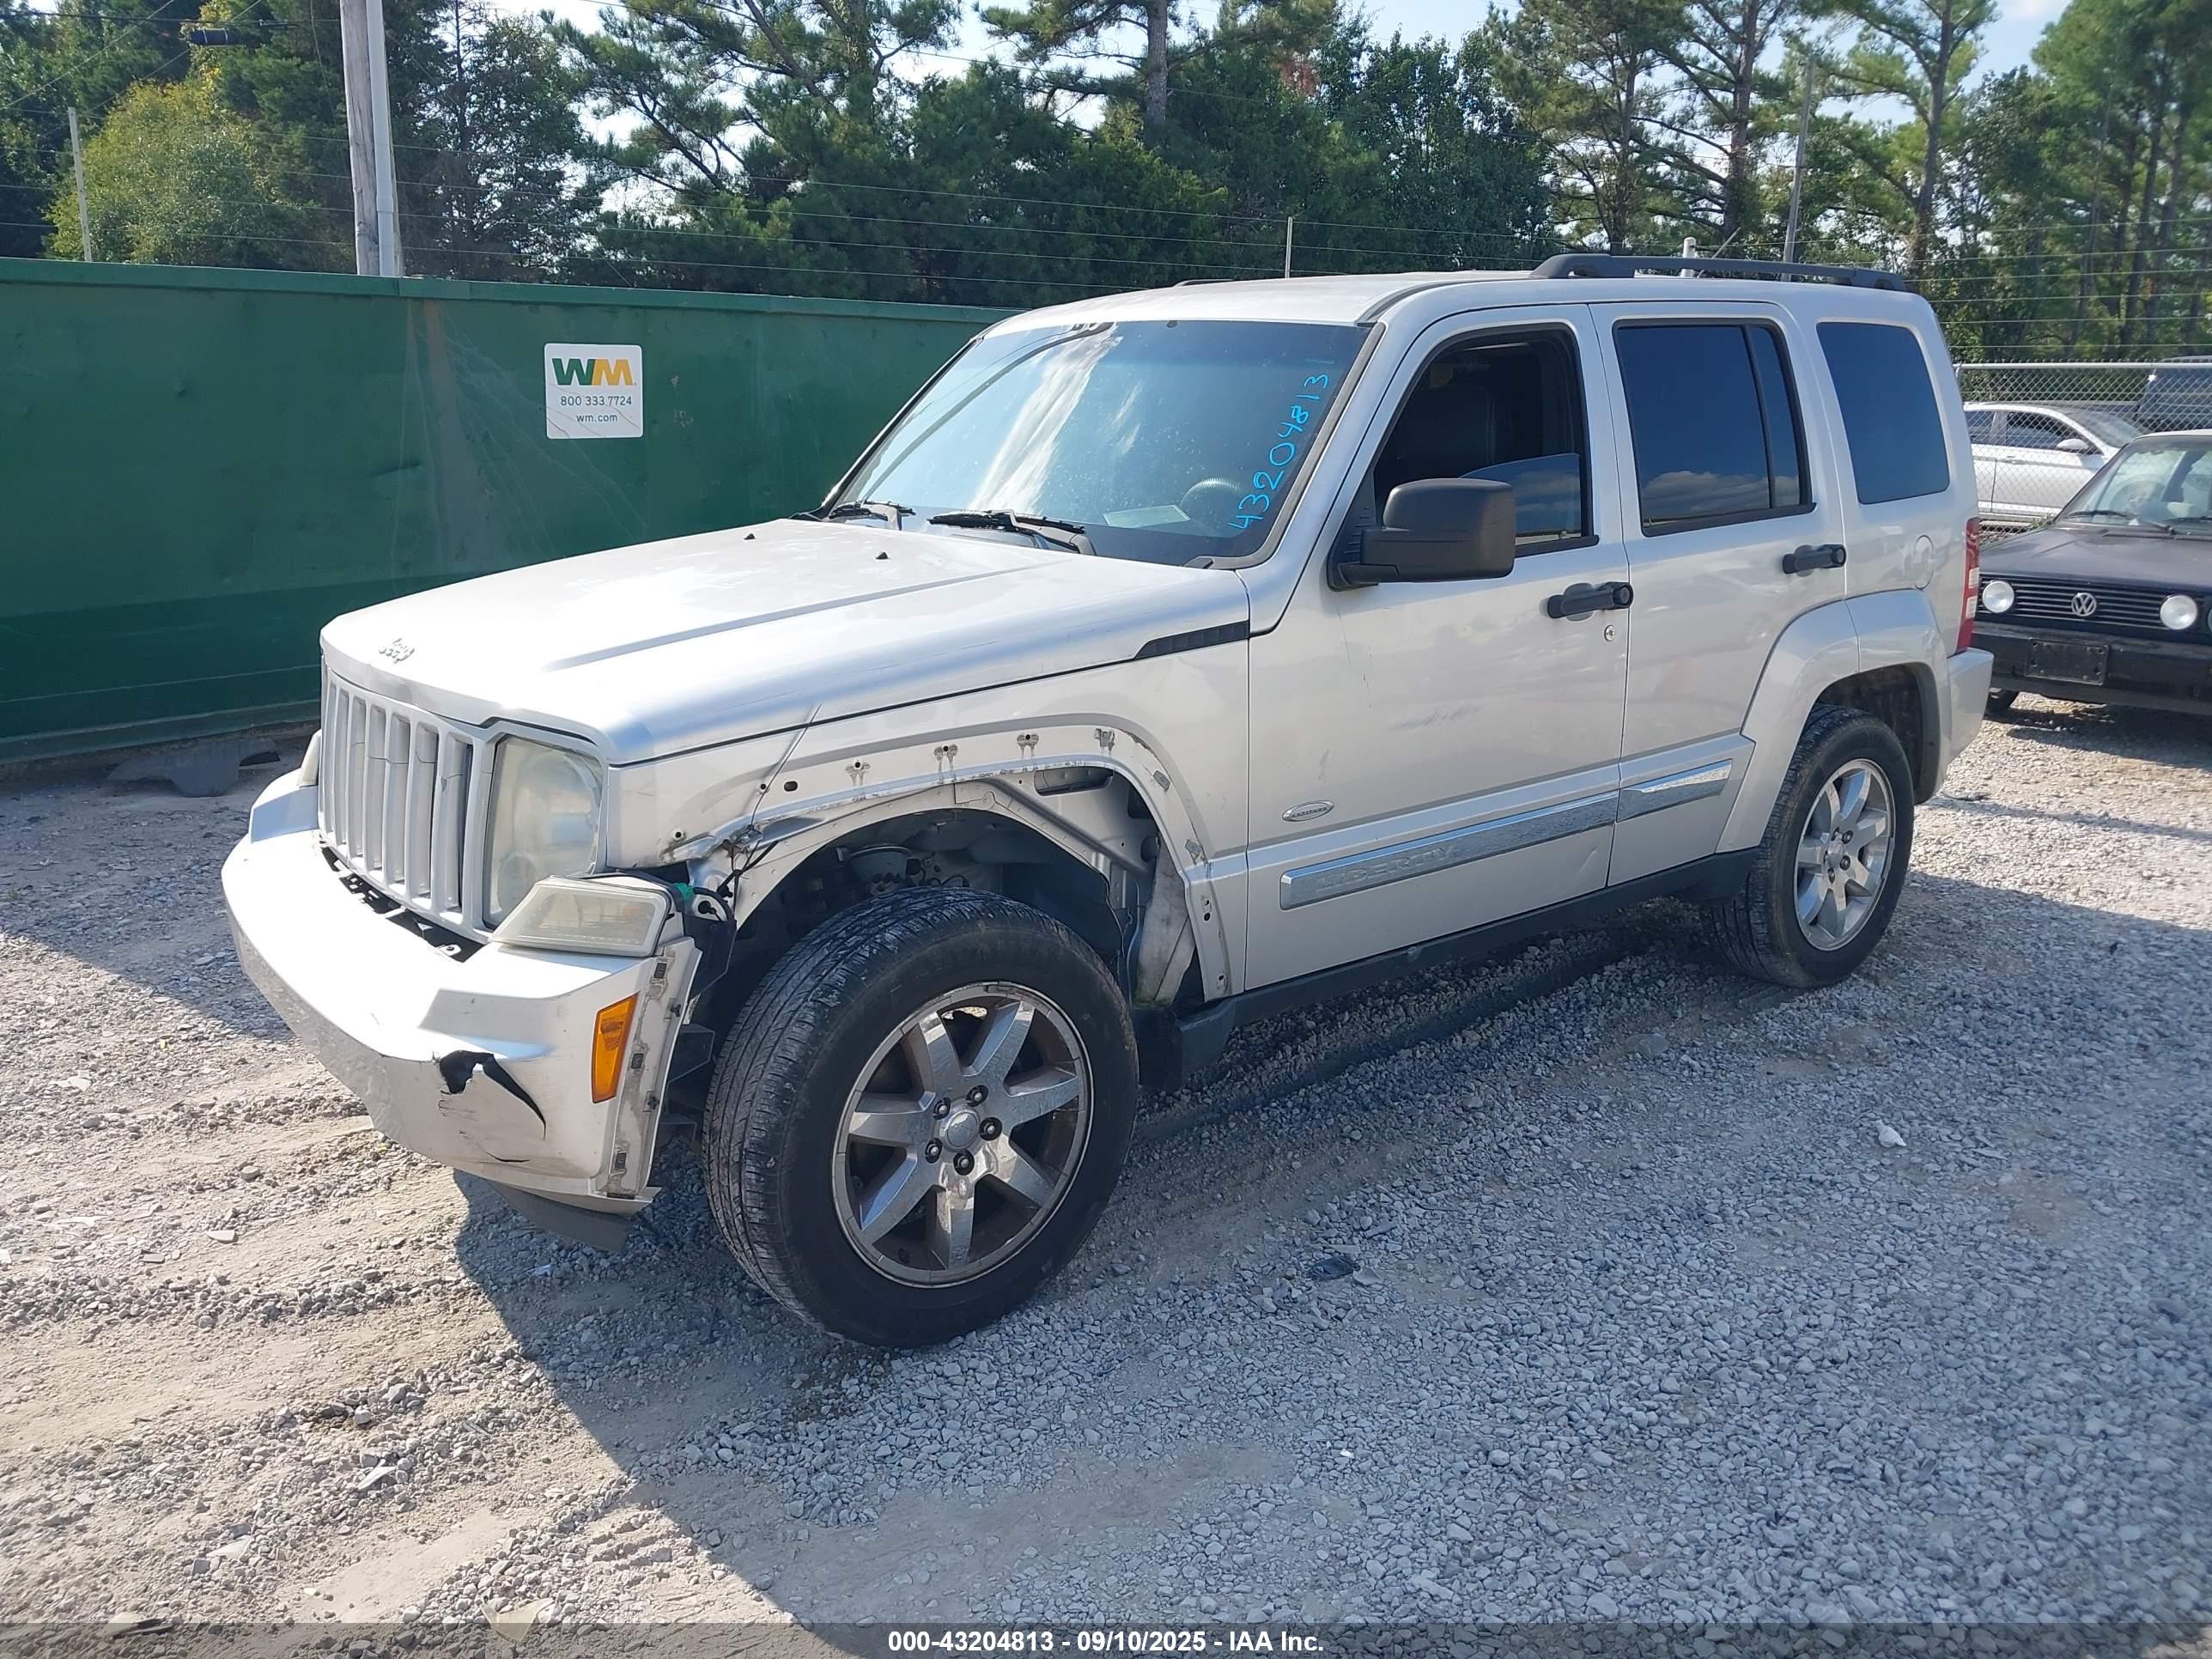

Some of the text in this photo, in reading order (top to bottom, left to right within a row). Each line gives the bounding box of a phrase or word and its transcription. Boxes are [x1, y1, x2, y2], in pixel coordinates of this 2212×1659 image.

[551, 358, 634, 386] WM
[561, 396, 632, 406] 800 333 7724
[576, 414, 618, 422] wm.com
